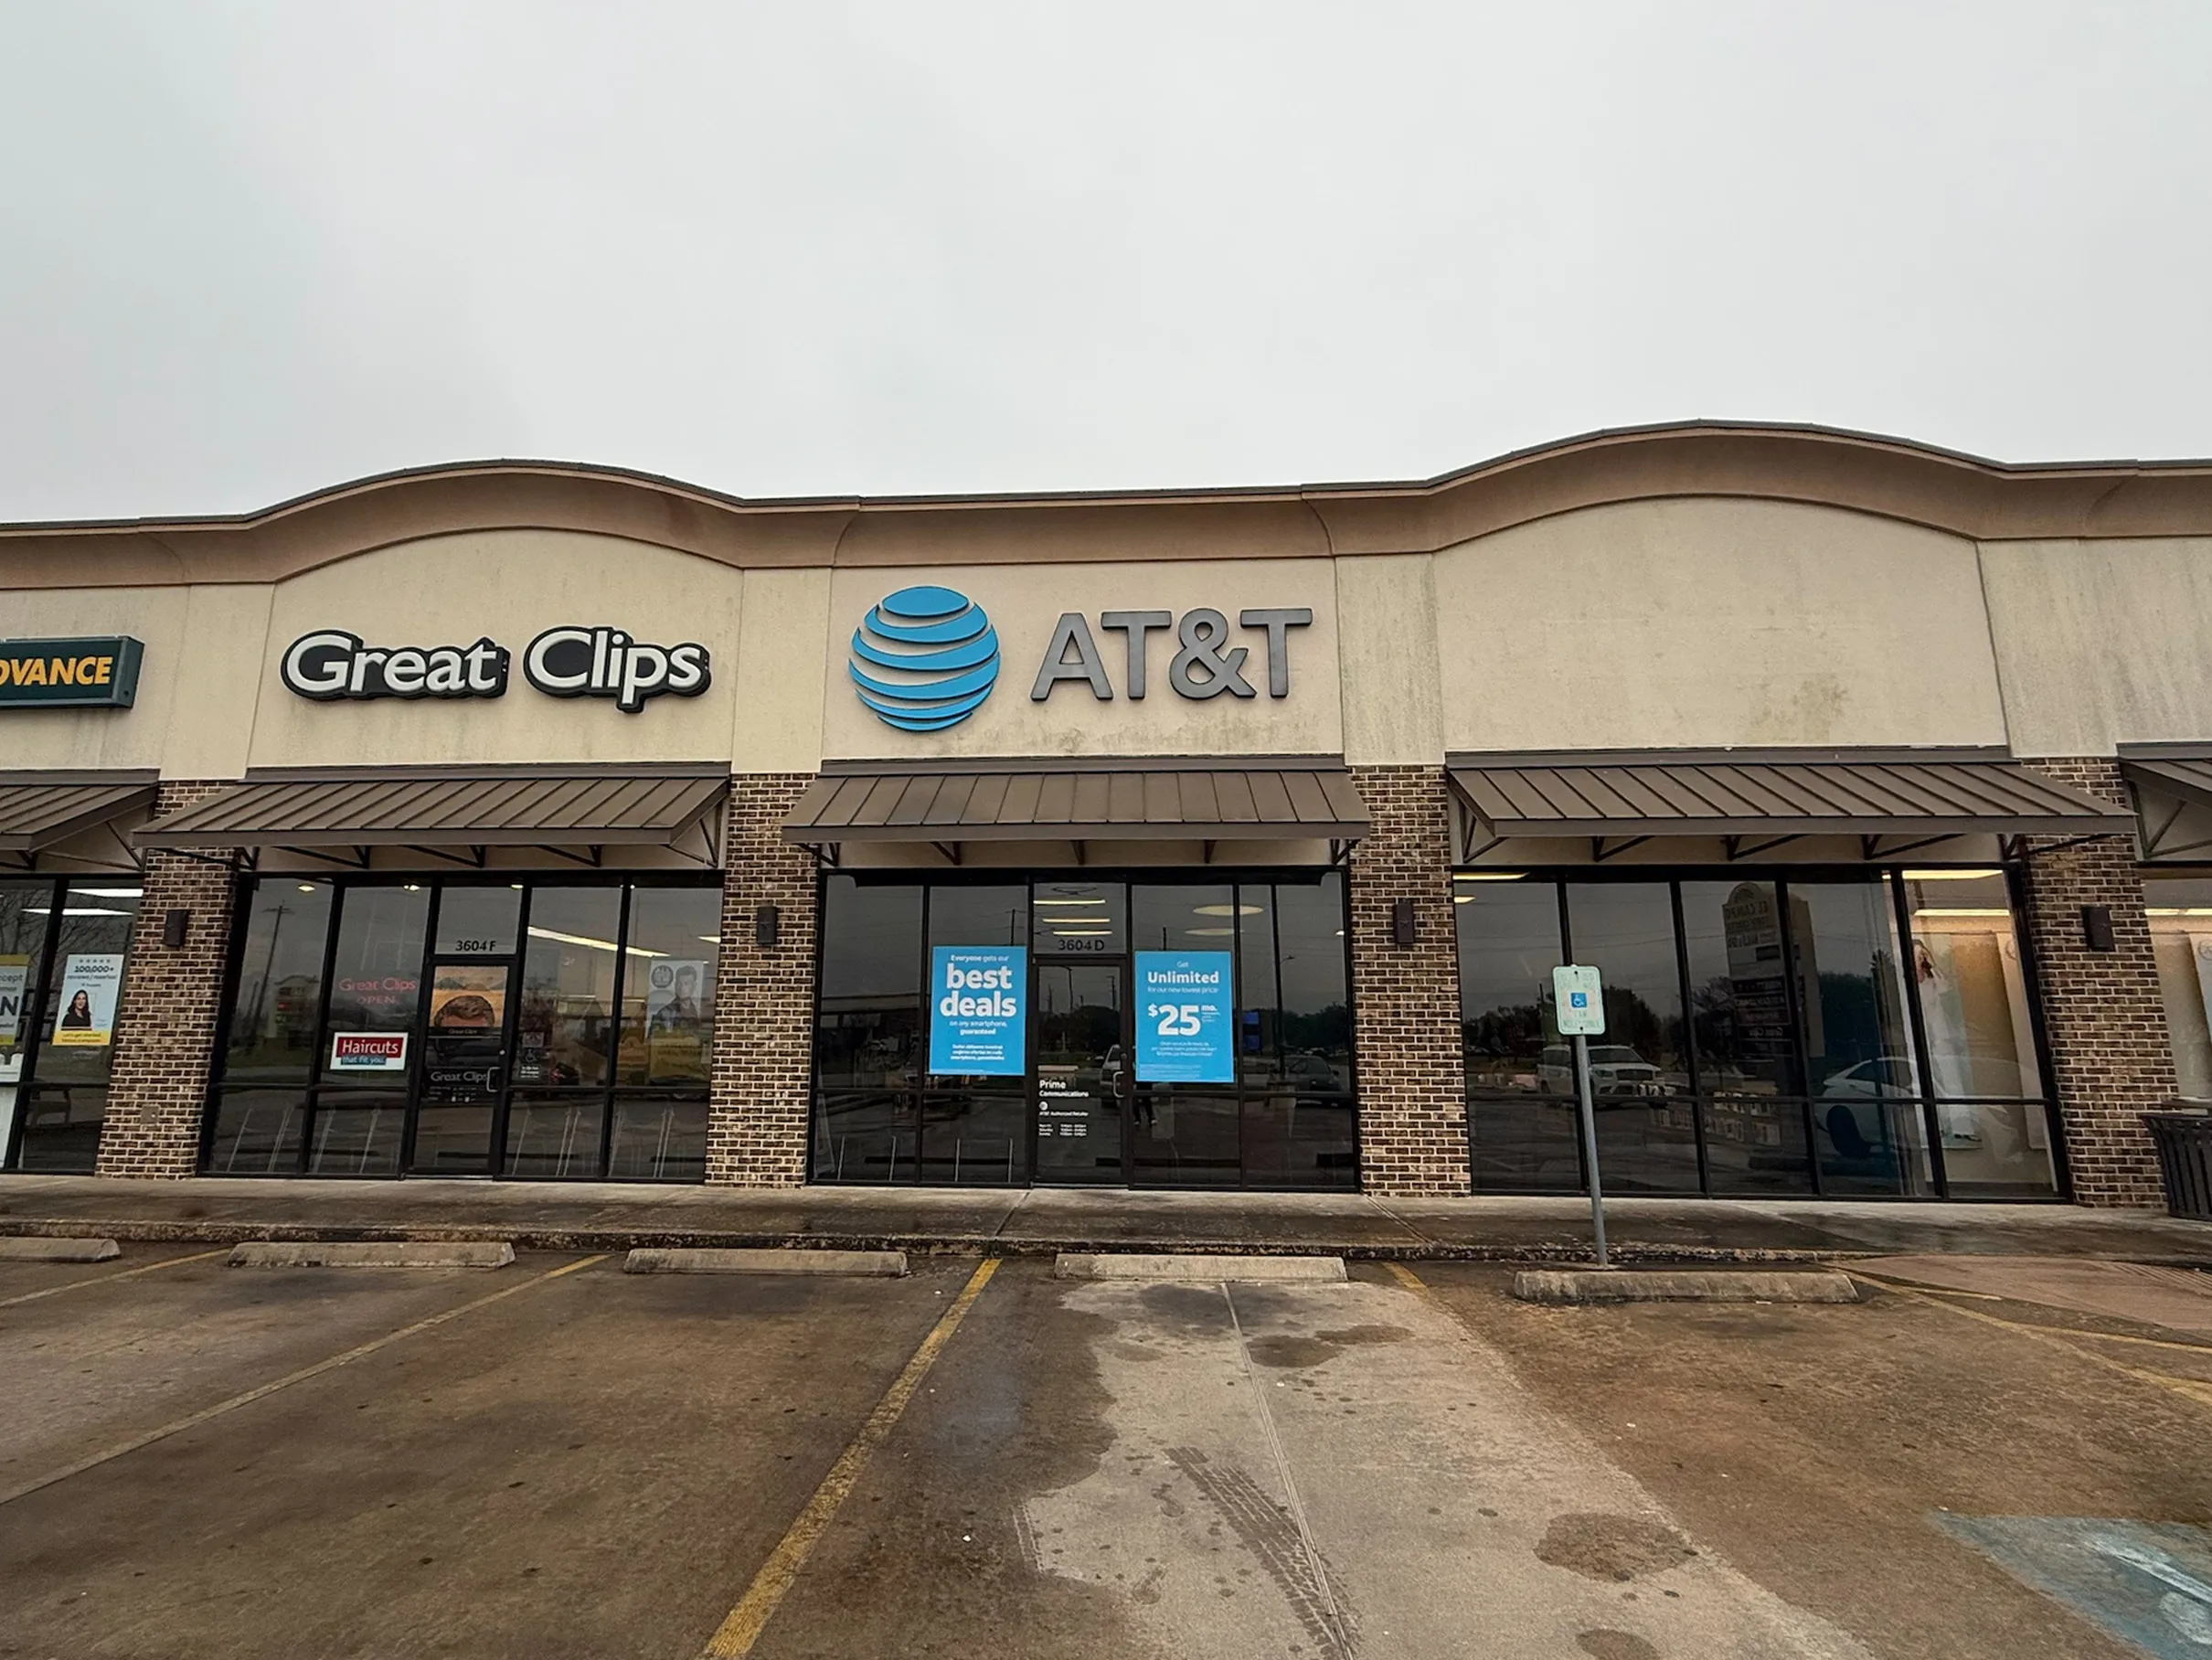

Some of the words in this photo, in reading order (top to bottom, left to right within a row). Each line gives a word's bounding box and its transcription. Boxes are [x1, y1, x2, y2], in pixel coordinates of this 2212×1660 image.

[1030, 608, 1313, 702] AT&T
[284, 631, 503, 695] Great
[526, 629, 703, 706] Clips
[455, 940, 486, 951] 3604
[1058, 940, 1092, 951] 3604
[951, 954, 982, 963] Everyone
[946, 963, 1013, 989] best
[1147, 970, 1219, 984] Unlimited
[338, 977, 379, 992] Great
[382, 976, 417, 993] Clips
[356, 995, 397, 1005] OPEN
[940, 990, 1017, 1017] deals
[1147, 1004, 1201, 1036] $25
[342, 1039, 399, 1054] Haircuts
[342, 1056, 357, 1064] that
[358, 1056, 369, 1064] fit
[431, 1071, 461, 1081] Great
[1039, 1080, 1067, 1089] Prime
